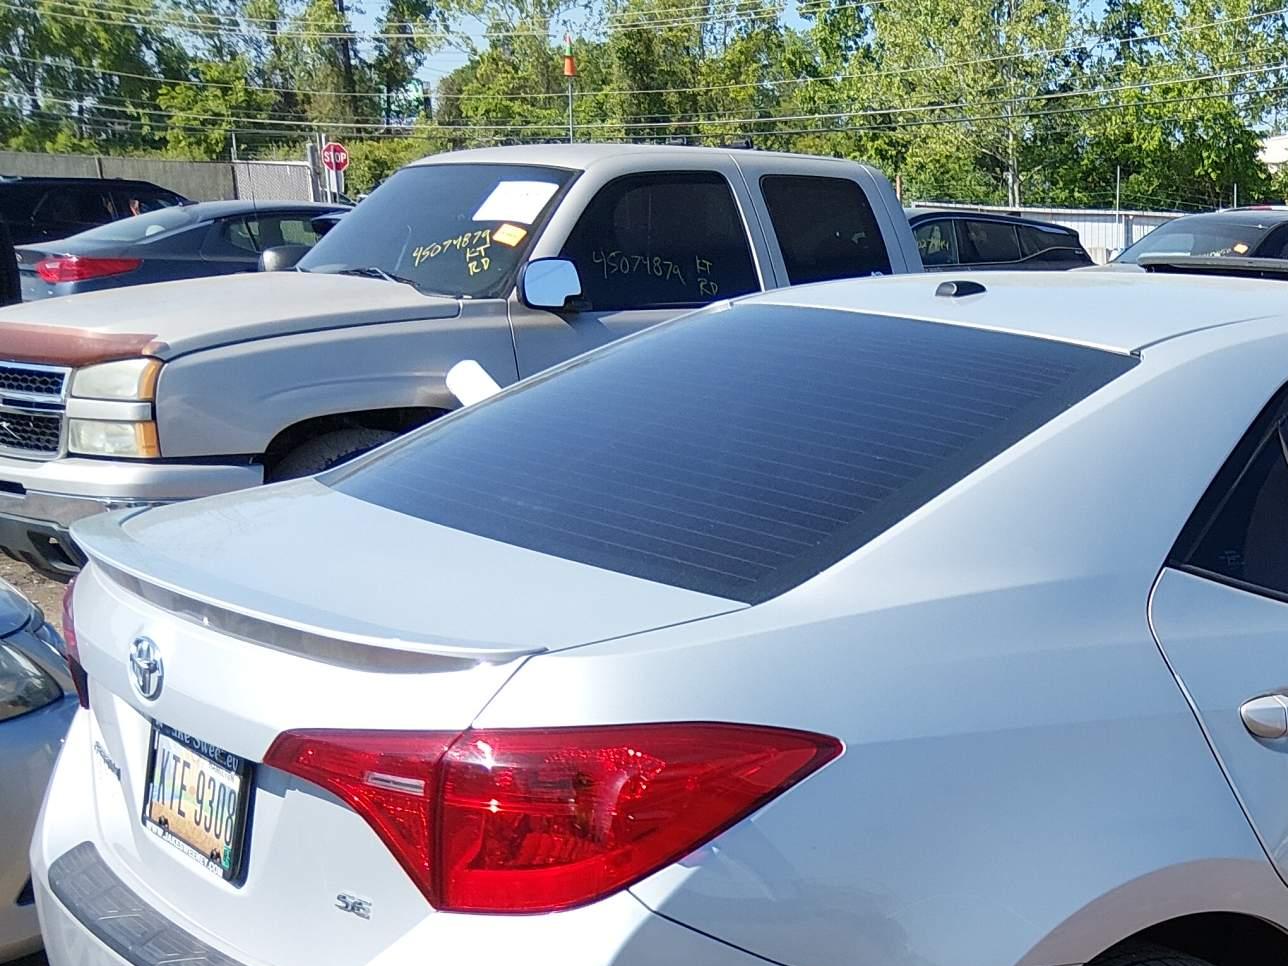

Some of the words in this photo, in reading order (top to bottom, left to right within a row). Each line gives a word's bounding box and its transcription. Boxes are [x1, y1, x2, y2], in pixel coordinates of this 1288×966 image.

[324, 151, 347, 163] STOP
[156, 747, 191, 818] KTE
[194, 768, 238, 847] 9308
[335, 892, 372, 920] SE
